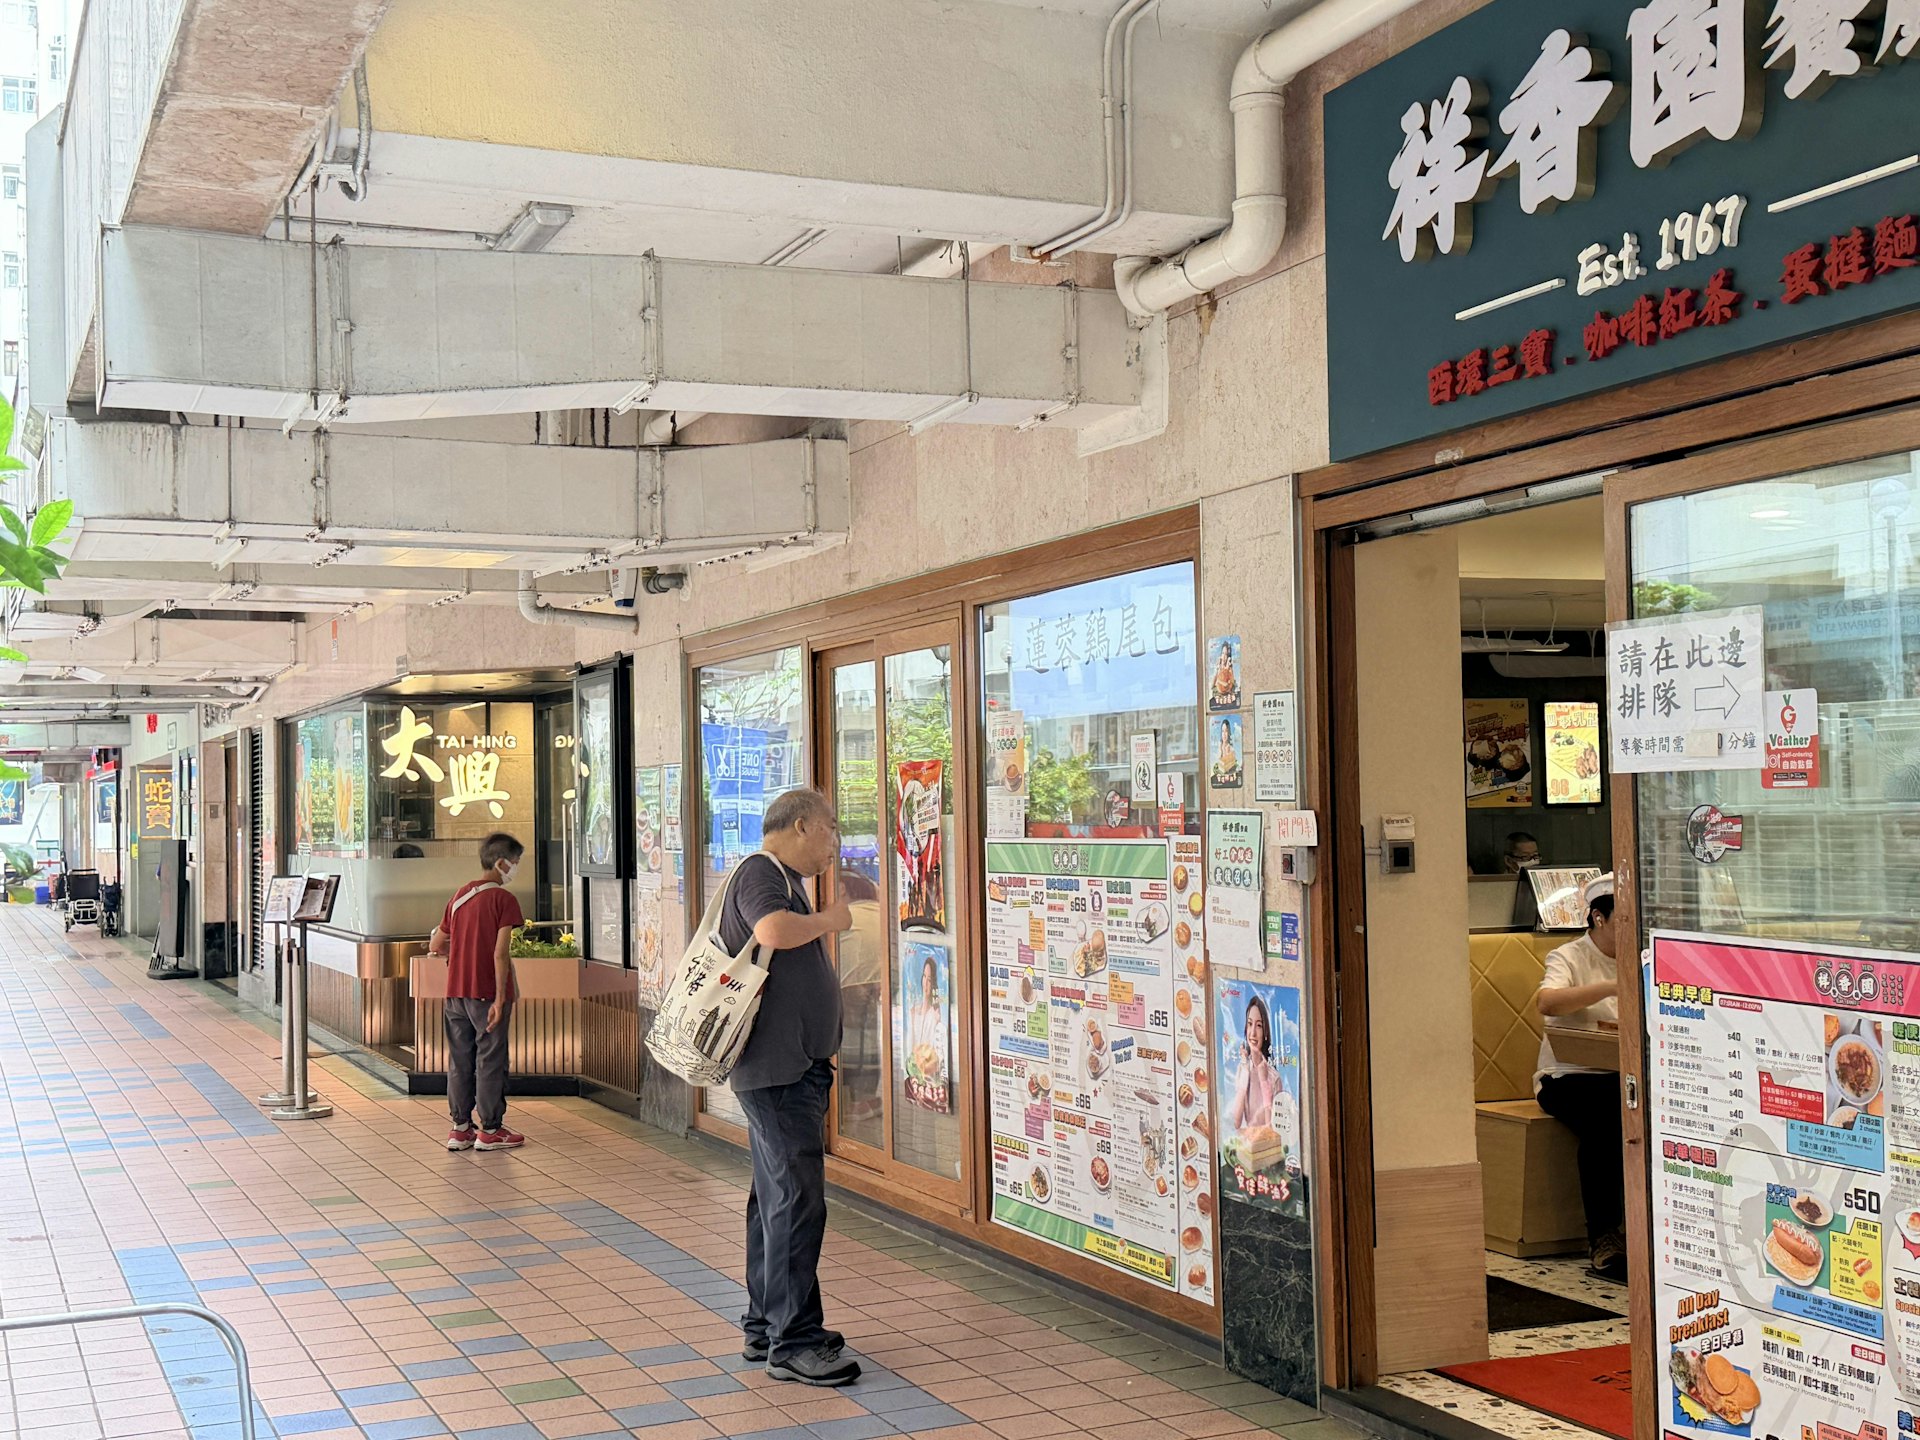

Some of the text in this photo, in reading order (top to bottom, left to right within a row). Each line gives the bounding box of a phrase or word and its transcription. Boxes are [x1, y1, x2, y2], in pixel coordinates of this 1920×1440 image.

[1577, 194, 1746, 296] Est. 1967
[1617, 626, 1747, 678] 請在此邊
[1617, 678, 1681, 720] 排隊
[436, 735, 517, 749] TAI HING
[1620, 735, 1685, 756] 等餐時間需
[1727, 731, 1757, 750] 分鐘
[1769, 732, 1810, 748] VGather
[1782, 750, 1813, 759] Self-ordering
[1031, 891, 1044, 905] $62
[1071, 897, 1086, 912] $69
[727, 979, 747, 993] HK
[1660, 982, 1712, 1005] 經典早餐
[1660, 1002, 1705, 1020] Breakfast
[1150, 1010, 1168, 1027] $65
[1014, 1020, 1026, 1033] $66
[1728, 1032, 1741, 1041] $40
[1728, 1050, 1741, 1059] $41
[1729, 1071, 1742, 1080] $40
[1729, 1089, 1743, 1098] $40
[1076, 1094, 1091, 1109] $66
[1729, 1110, 1743, 1119] $40
[1730, 1128, 1742, 1137] $41
[1097, 1140, 1111, 1154] $69
[1664, 1160, 1733, 1187] Deluxe Breakfast
[1010, 1181, 1022, 1196] $65
[1664, 1179, 1668, 1187] 1
[1664, 1197, 1668, 1205] 2
[1844, 1187, 1881, 1214] $50
[1665, 1218, 1669, 1227] 3
[1665, 1236, 1669, 1245] 4
[1862, 1231, 1877, 1240] choice
[1665, 1255, 1669, 1263] 5
[1677, 1289, 1719, 1319] All Day
[1670, 1308, 1729, 1344] Breakfast
[1701, 1328, 1744, 1355] 全日早餐
[1762, 1339, 1779, 1355] 豬扒
[1787, 1347, 1804, 1363] 雞扒
[1812, 1355, 1829, 1371] 牛扒
[1763, 1362, 1796, 1381] 吉列豬扒
